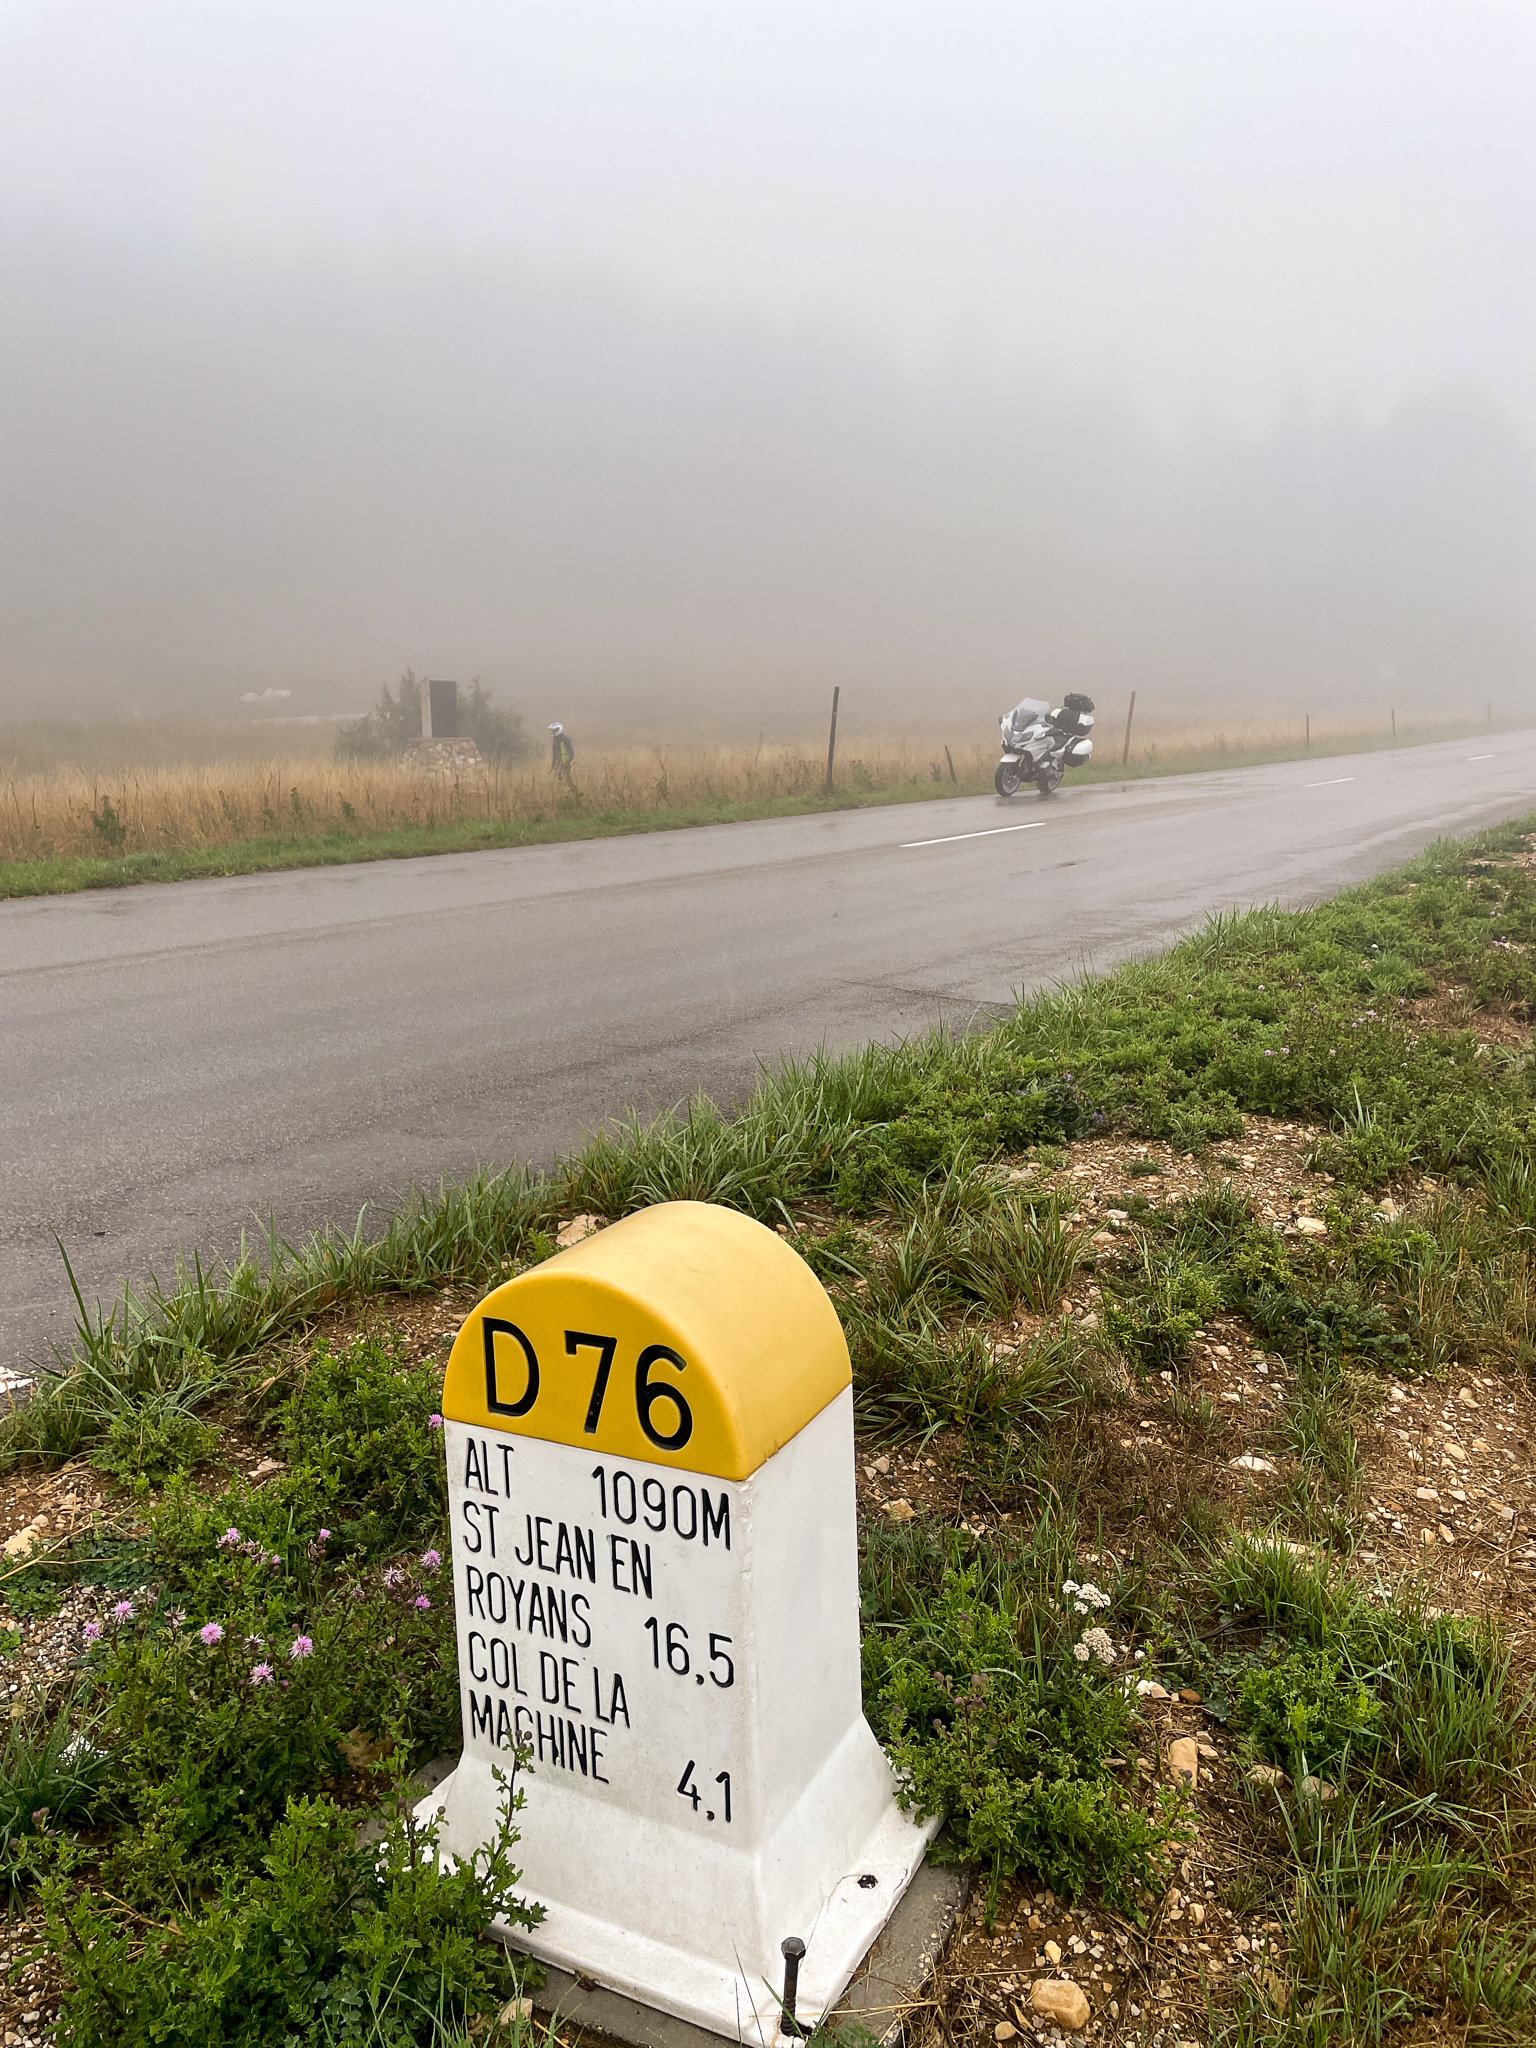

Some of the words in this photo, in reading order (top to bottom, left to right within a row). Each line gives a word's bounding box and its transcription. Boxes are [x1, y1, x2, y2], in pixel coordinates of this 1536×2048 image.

[482, 1317, 540, 1417] D
[564, 1330, 693, 1451] 76
[465, 1437, 514, 1498] ALT
[592, 1466, 731, 1550] 1090M
[463, 1501, 499, 1558] ST
[515, 1514, 596, 1584] JEAN
[610, 1534, 653, 1599] EN
[466, 1565, 592, 1648] ROYANS
[468, 1631, 527, 1696] COL
[539, 1651, 582, 1714] DE
[593, 1667, 631, 1729] LA
